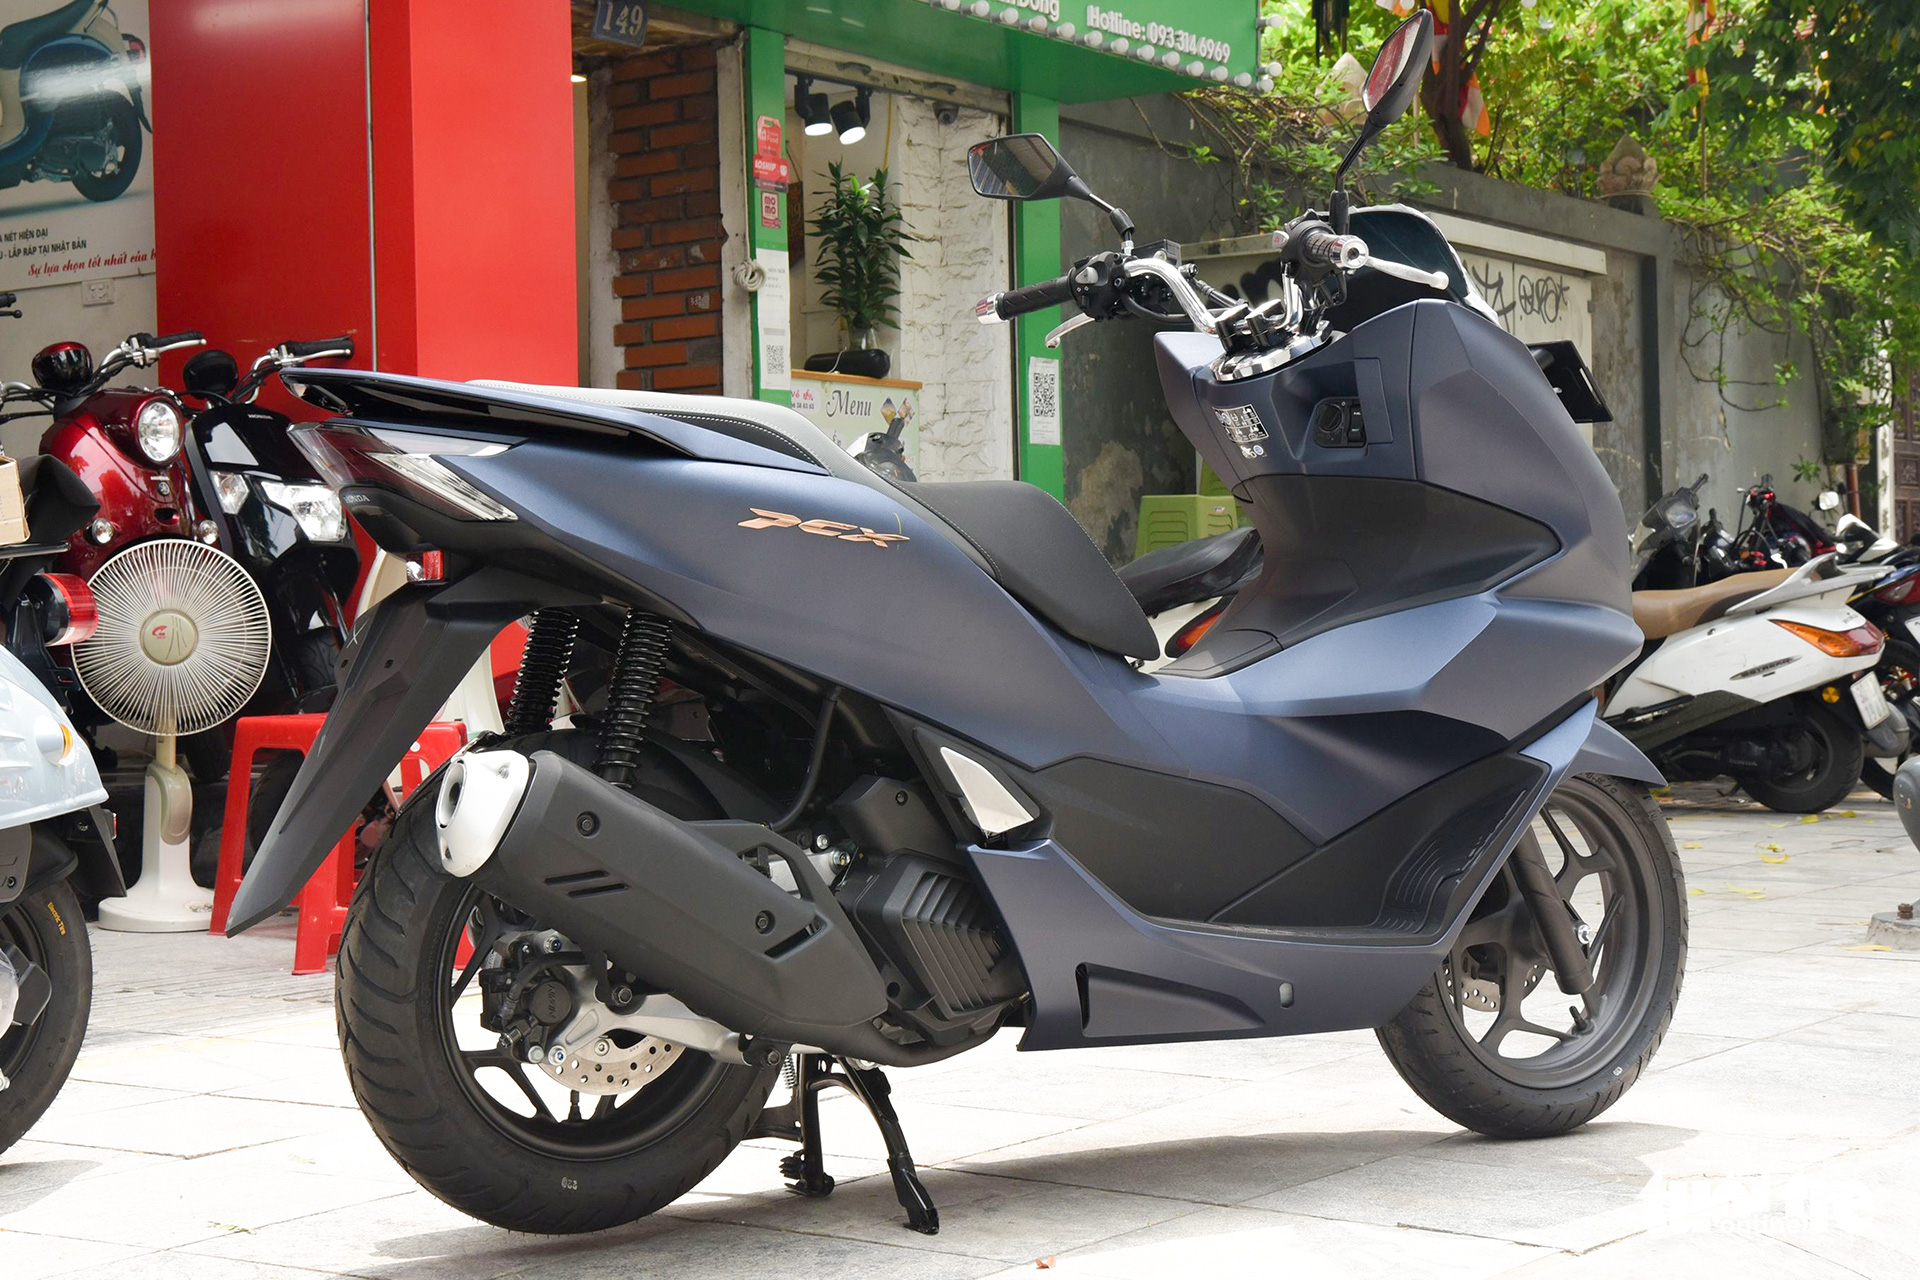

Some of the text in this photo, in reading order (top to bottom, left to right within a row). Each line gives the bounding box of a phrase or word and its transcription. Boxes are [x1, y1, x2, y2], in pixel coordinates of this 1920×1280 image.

[602, 0, 644, 37] 149
[1086, 4, 1146, 41] Hotline:
[38, 244, 50, 256] TẠI
[62, 259, 85, 273] chọn
[104, 251, 127, 267] nhất
[825, 390, 872, 417] Menu
[738, 507, 911, 548] PCX
